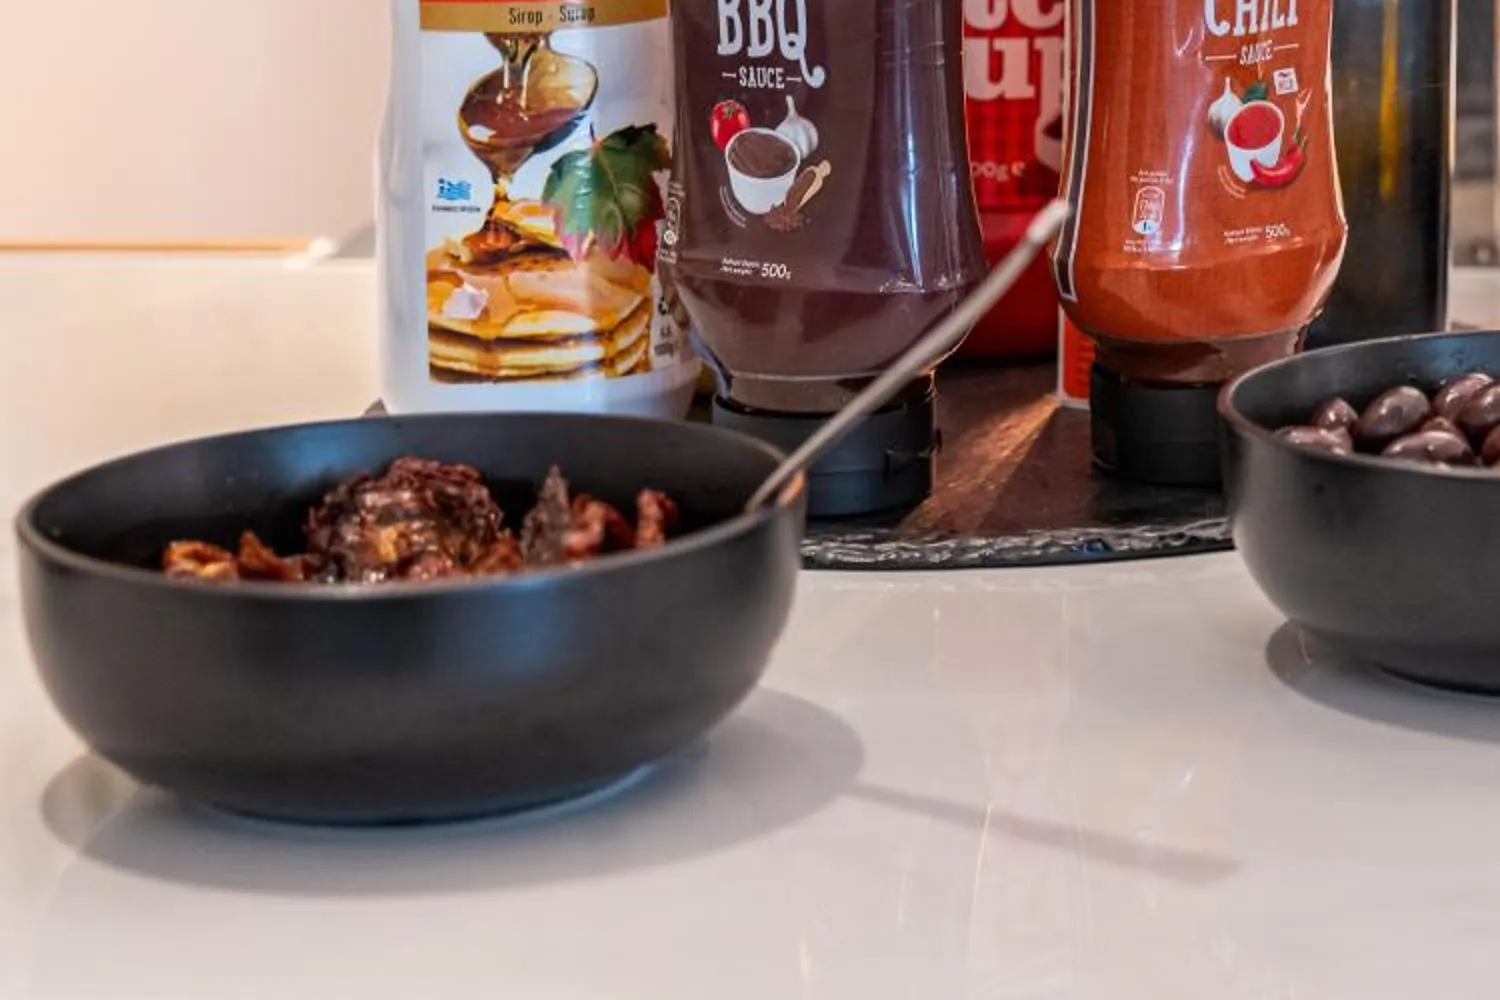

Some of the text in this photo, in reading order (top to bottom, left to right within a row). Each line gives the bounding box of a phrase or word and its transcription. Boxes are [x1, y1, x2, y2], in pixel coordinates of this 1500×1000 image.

[509, 7, 543, 26] Sirop
[1239, 39, 1273, 65] SAUCE
[739, 66, 785, 89] SAUCE
